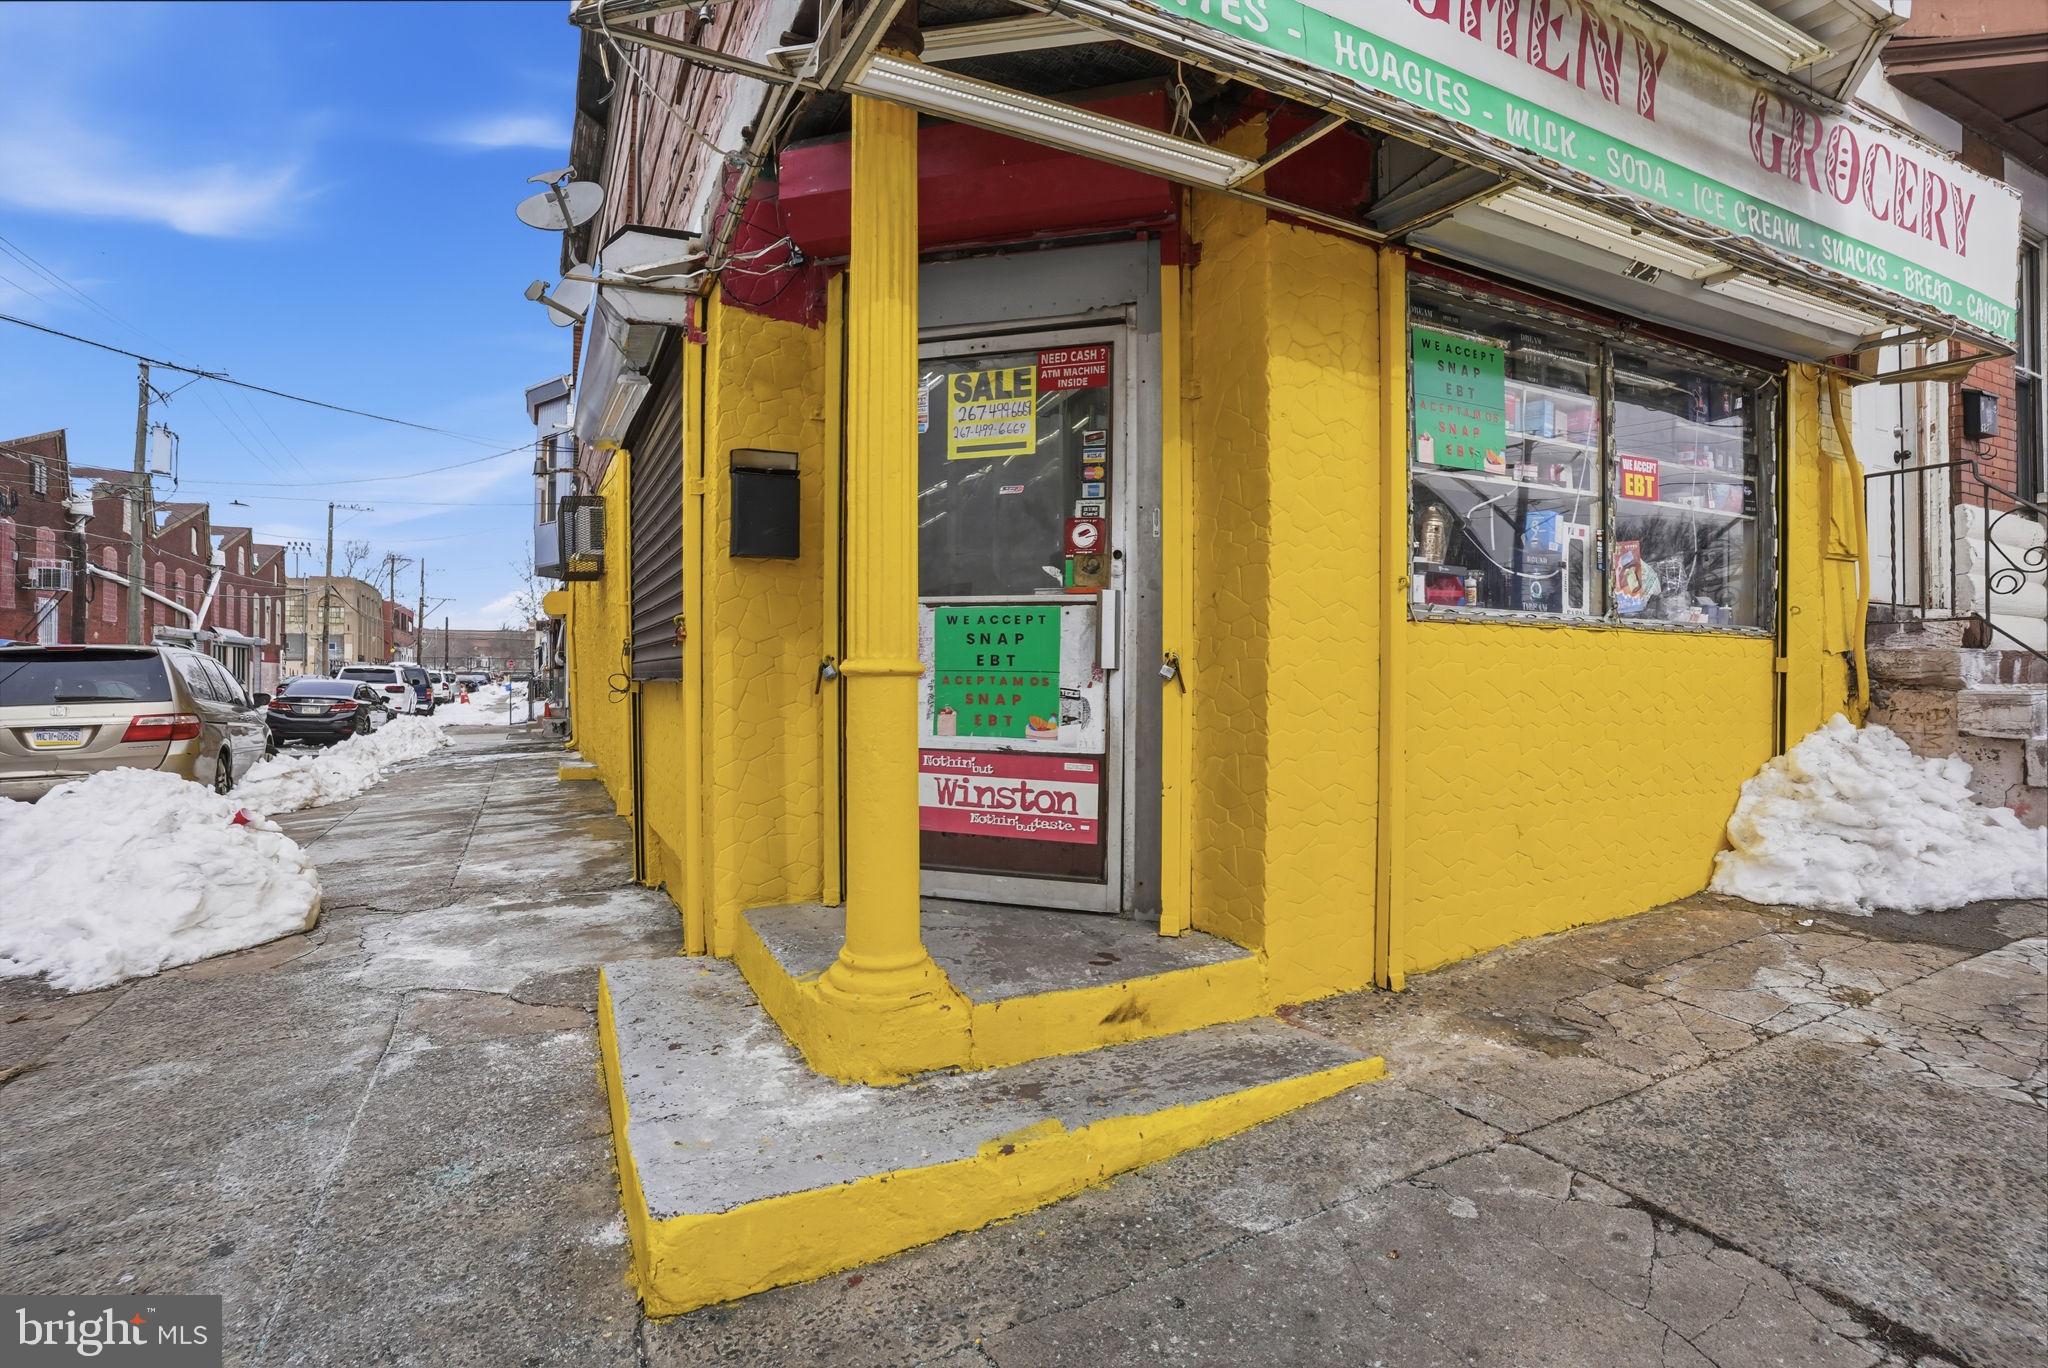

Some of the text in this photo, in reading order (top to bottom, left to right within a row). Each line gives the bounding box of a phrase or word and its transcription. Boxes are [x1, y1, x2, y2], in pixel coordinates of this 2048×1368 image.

[1409, 0, 1977, 258] MENY GROCERY
[1333, 30, 1472, 118] HOAGIES
[1505, 102, 1578, 160] MILK
[1606, 147, 1669, 199] SODA
[1693, 182, 1727, 221] ICE
[1733, 201, 1802, 250] CREAM
[1821, 234, 1889, 282] SNACKS
[1902, 265, 1953, 306] BREAD
[1966, 295, 2011, 335] CANDY
[1040, 348, 1106, 364] NEED CASH ?
[1422, 337, 1495, 363] WE ACCEPT
[1041, 365, 1106, 379] ATM MACHINE
[1437, 360, 1480, 379] SNAP
[953, 368, 1032, 404] SALE
[1057, 377, 1088, 388] INSIDE
[1446, 382, 1475, 399] EBT
[1420, 400, 1500, 423] ACEPTAMOS
[1439, 421, 1480, 438] SNAP
[1622, 457, 1657, 475] WE ACCEPT
[1624, 472, 1656, 499] EBT
[946, 613, 1047, 625] WE ACCEPT
[966, 632, 1025, 645] SNAP
[976, 654, 1016, 667] EBT
[942, 675, 1050, 687] ACEPTAMOS
[965, 693, 1022, 706] SNAP
[974, 713, 1014, 727] EBT
[922, 754, 994, 775] Nothin' but
[934, 776, 1079, 816] Winston
[969, 812, 1076, 833] Nothin' but taste.
